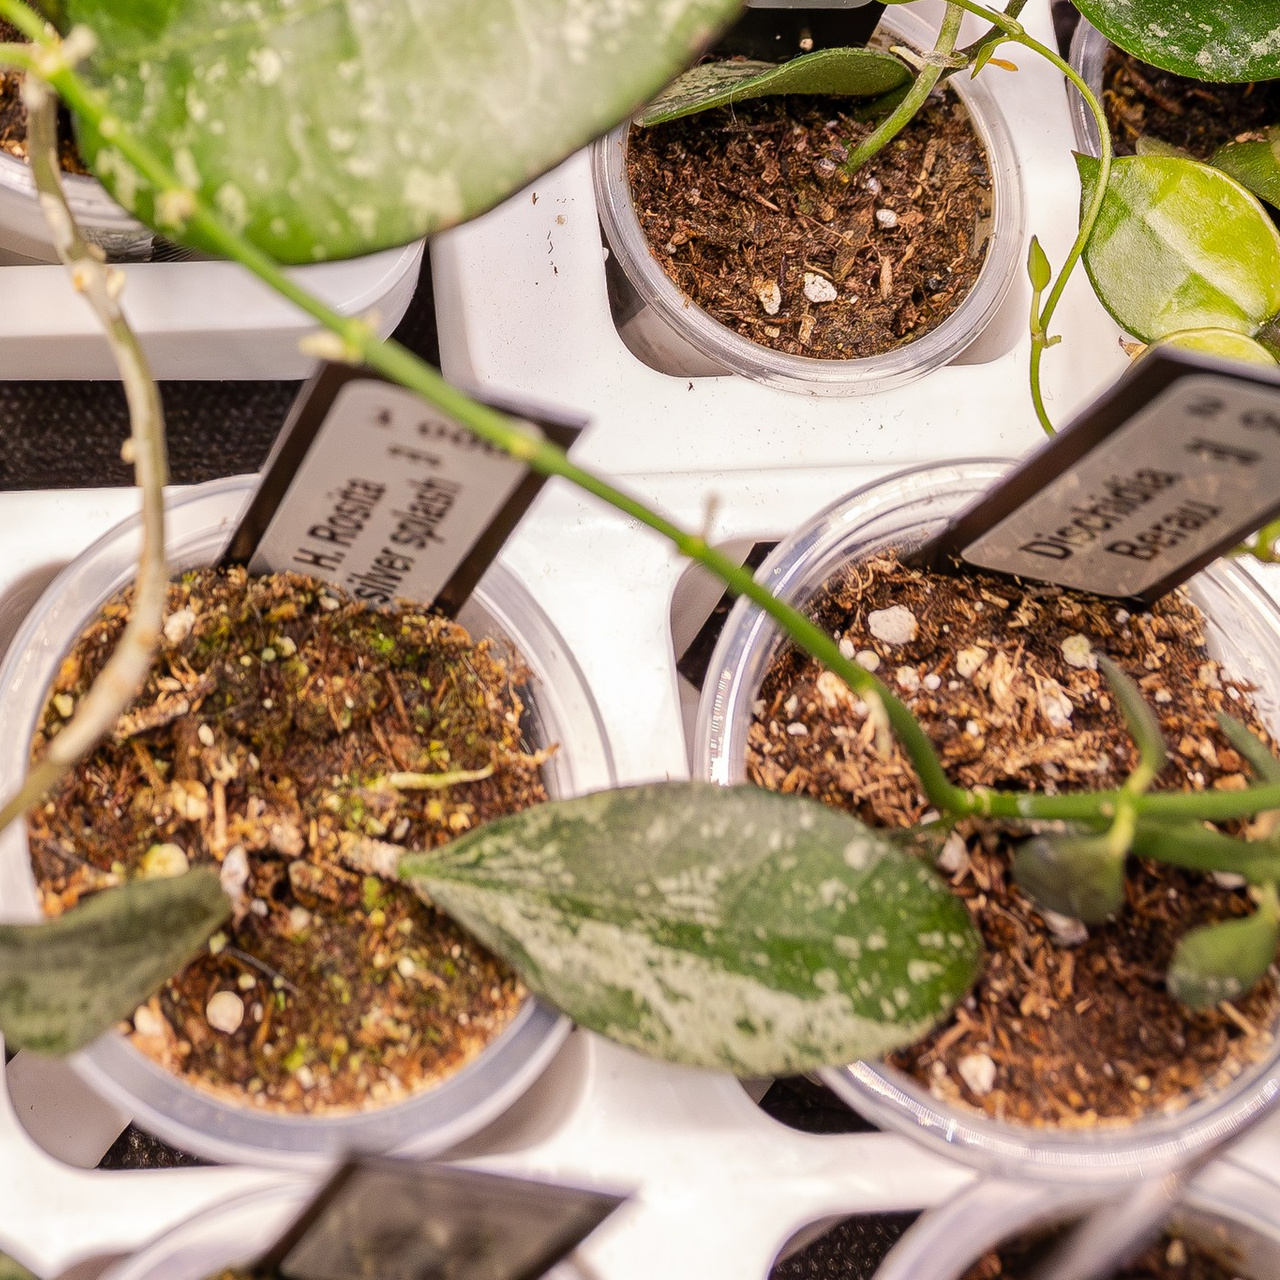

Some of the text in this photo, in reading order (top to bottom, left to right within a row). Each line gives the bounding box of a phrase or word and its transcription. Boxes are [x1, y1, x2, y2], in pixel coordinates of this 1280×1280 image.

[292, 478, 388, 572] H. Rosita
[346, 545, 417, 605] silver
[390, 476, 464, 550] splash
[1019, 467, 1182, 560] Dischidia
